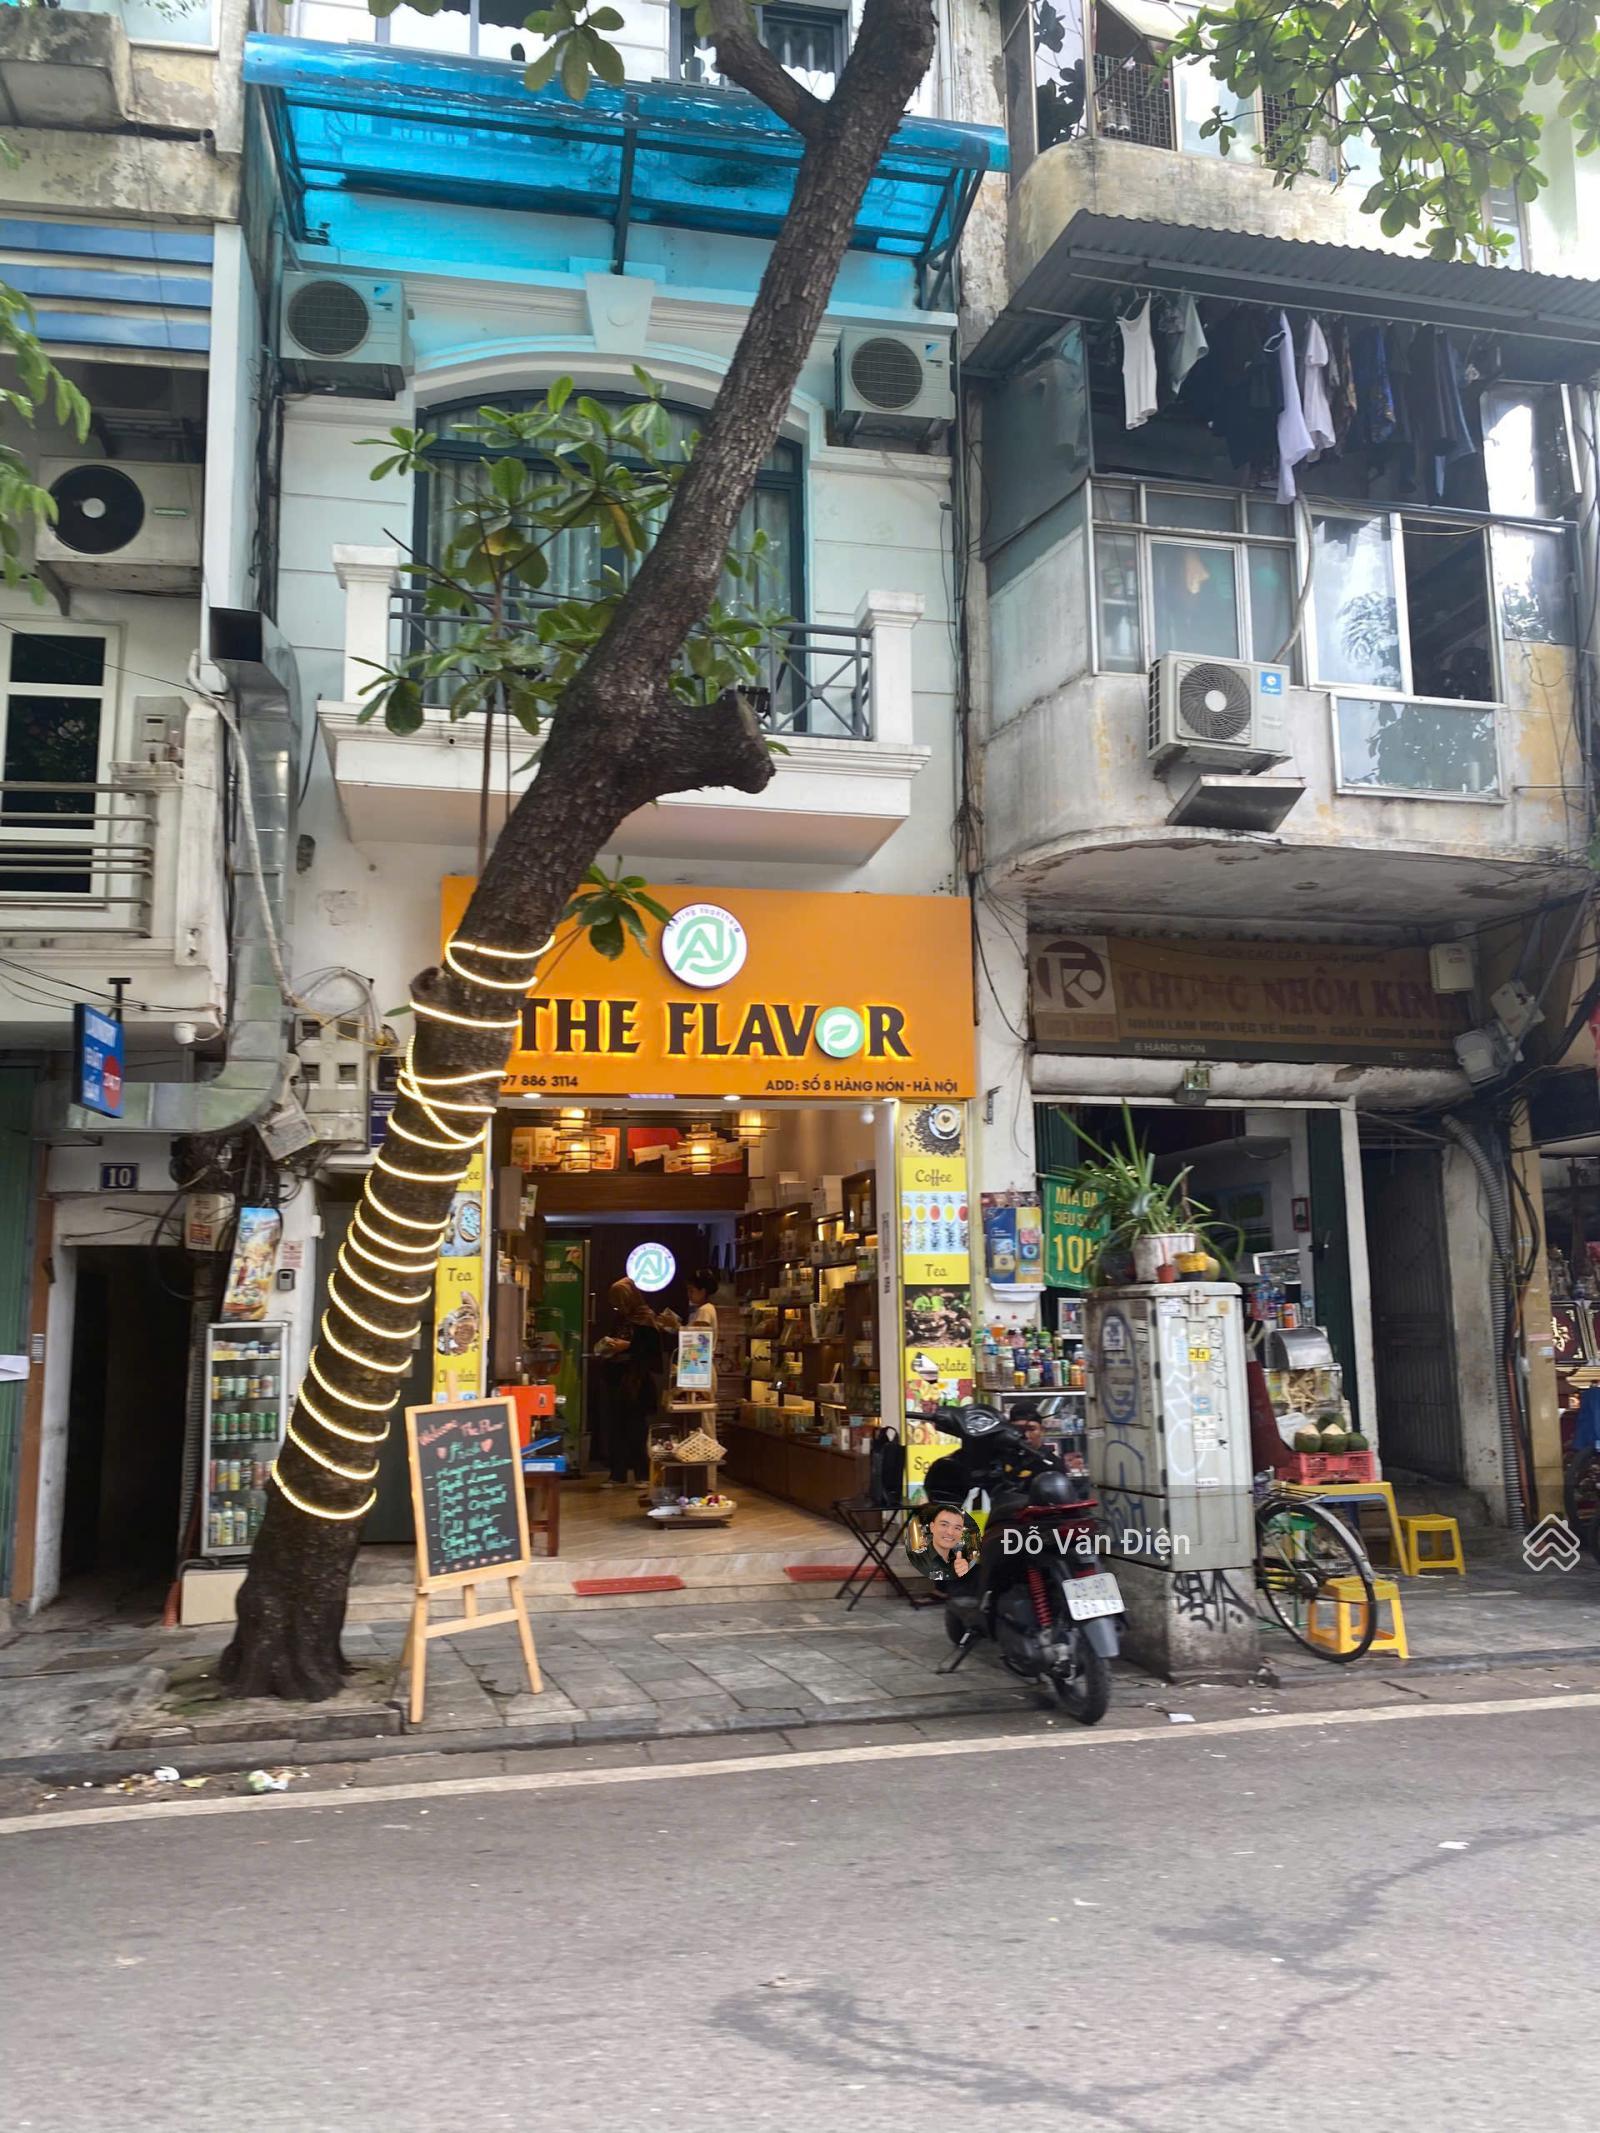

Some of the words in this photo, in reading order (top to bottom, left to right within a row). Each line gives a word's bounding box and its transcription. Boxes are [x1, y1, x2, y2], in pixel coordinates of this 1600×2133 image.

[1263, 966, 1365, 1018] NHÔM
[517, 998, 638, 1053] THE
[522, 1075, 546, 1086] 886
[552, 1075, 578, 1087] 3114
[802, 1073, 821, 1091] SỐ
[823, 1079, 830, 1091] 8
[834, 1076, 873, 1092] HÀNG
[875, 1076, 905, 1092] NÓN
[913, 1076, 931, 1092] HÀ
[934, 1077, 958, 1095] NỘI
[109, 1168, 131, 1186] 10
[915, 1169, 953, 1186] Coffee
[447, 1267, 473, 1282] Tea
[924, 1263, 949, 1277] Tea
